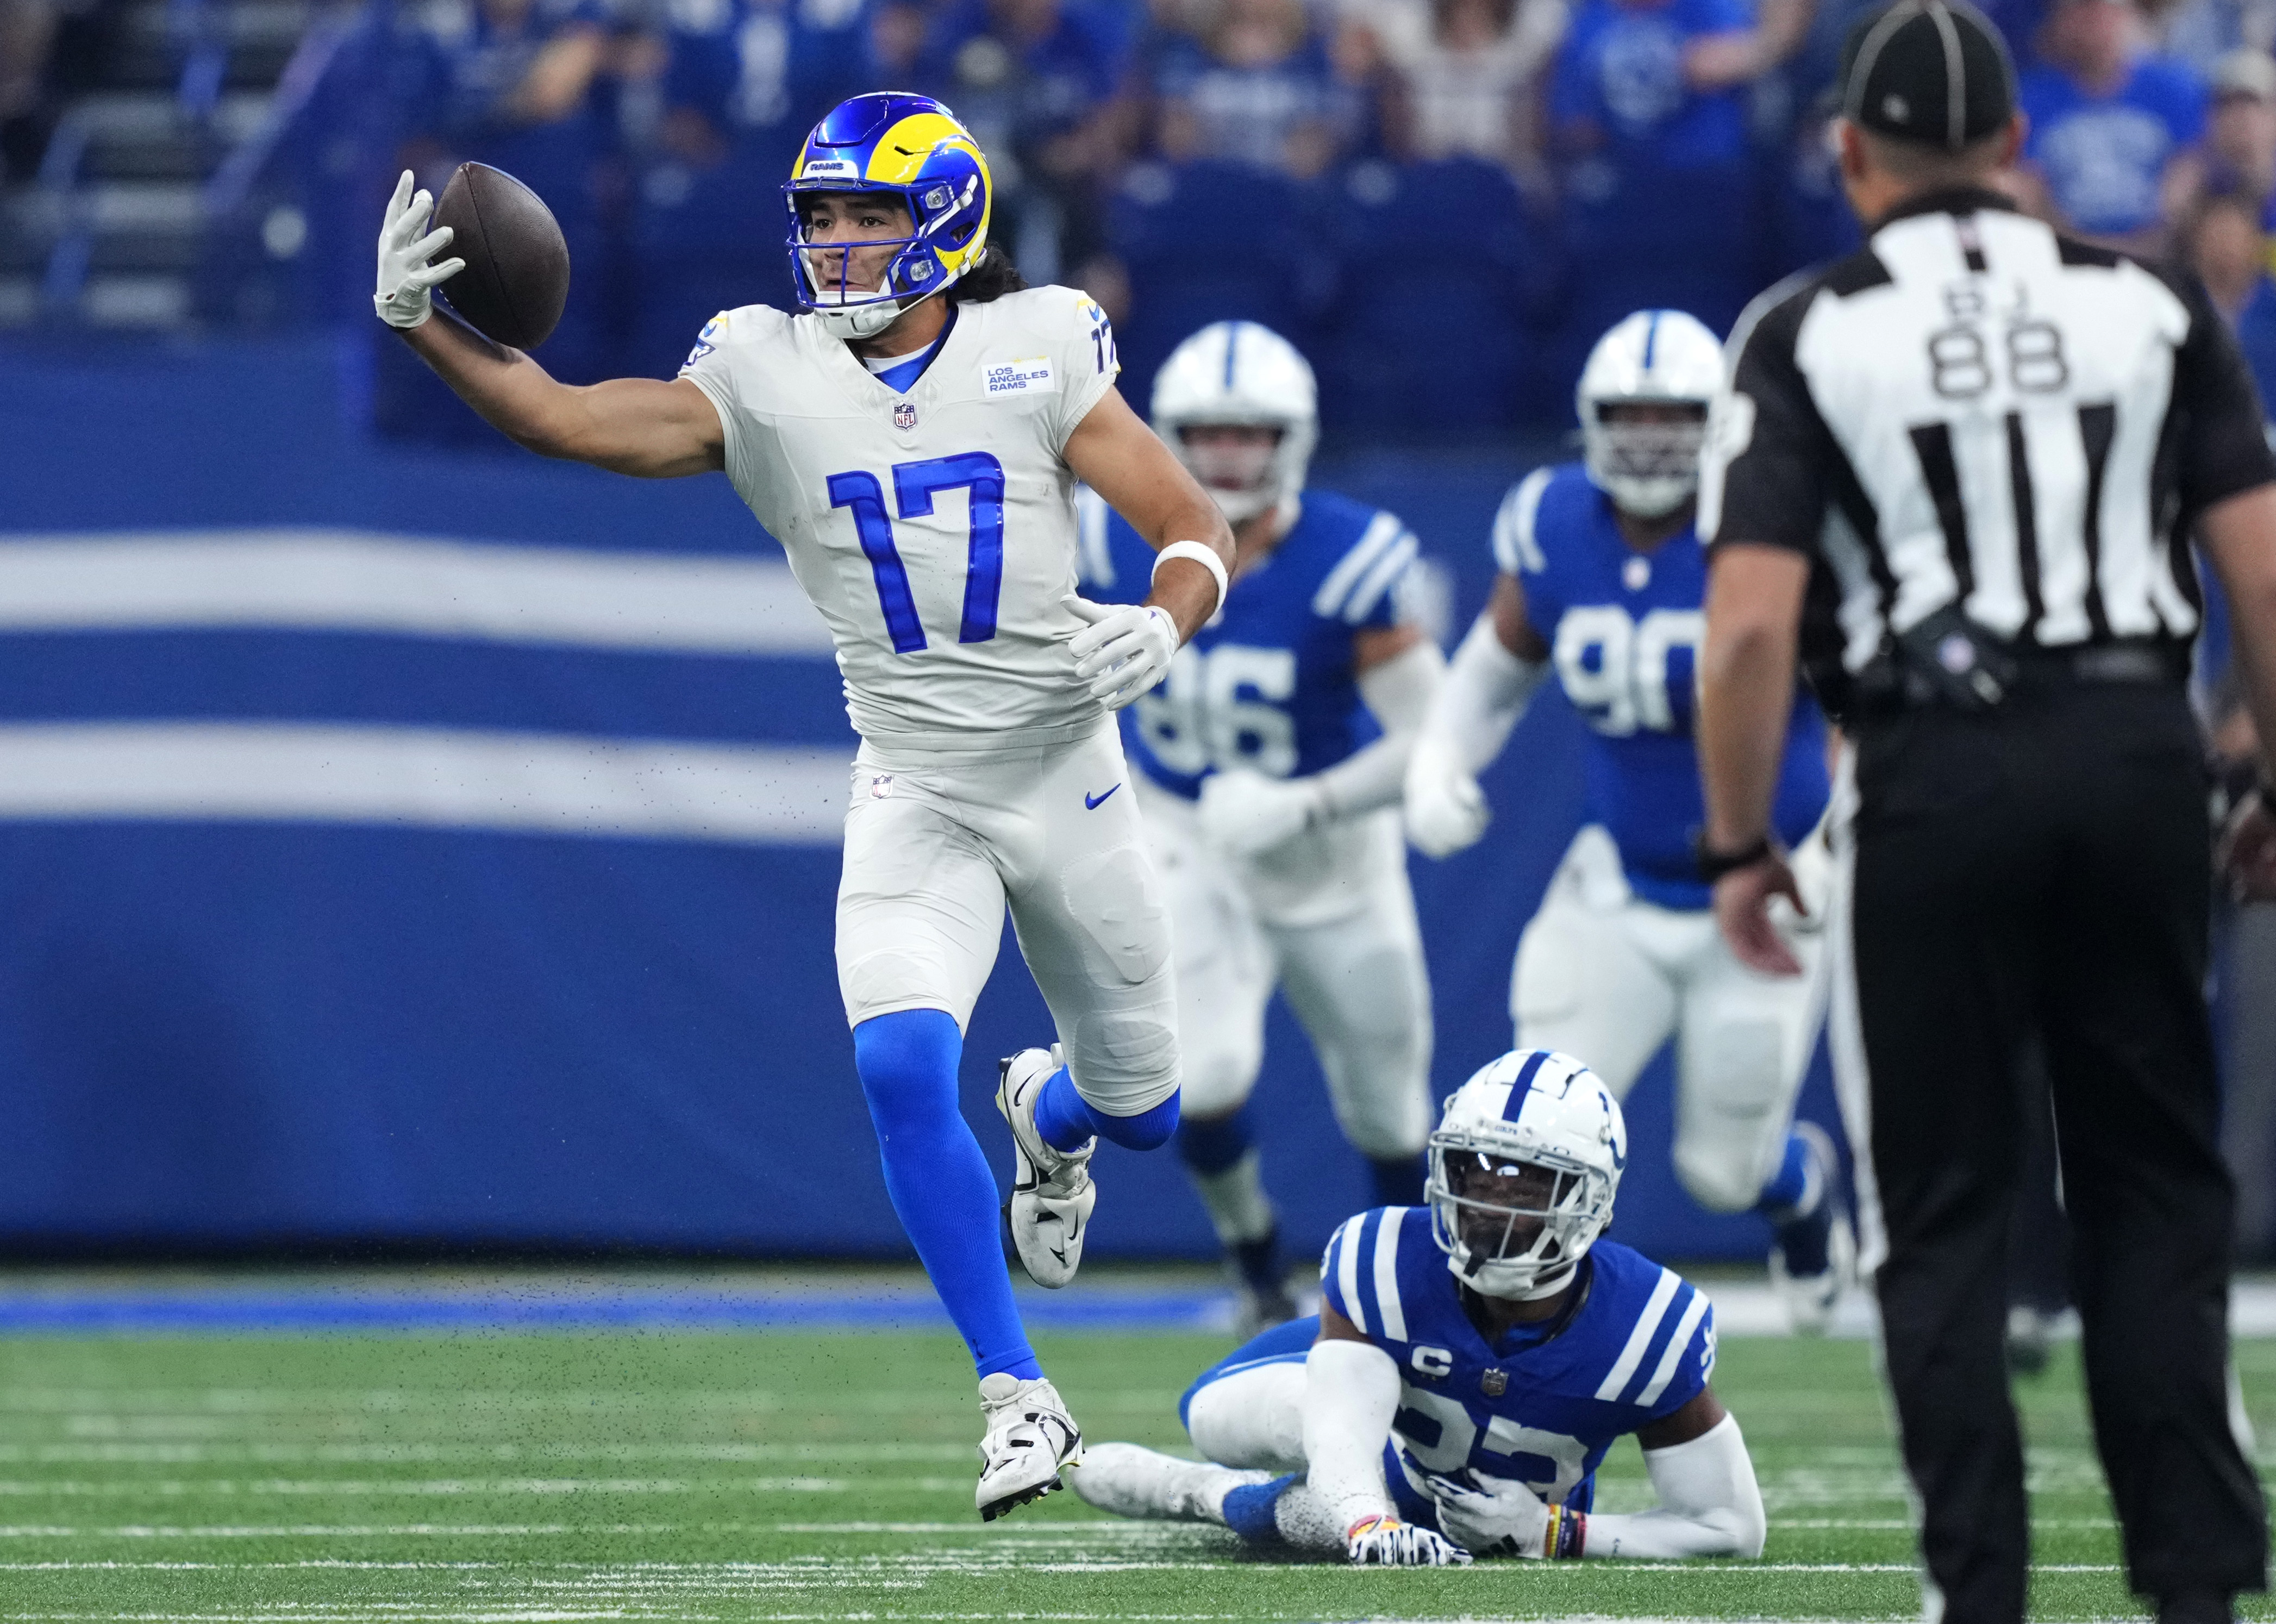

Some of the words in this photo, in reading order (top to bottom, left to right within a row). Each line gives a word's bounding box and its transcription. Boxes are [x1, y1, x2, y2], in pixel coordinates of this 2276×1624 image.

[810, 162, 845, 171] RAMS
[1927, 322, 2069, 402] 88
[988, 367, 1013, 376] LOS
[989, 370, 1049, 384] ANGELES
[990, 381, 1027, 392] RAMS
[897, 414, 914, 426] NFL
[826, 451, 1005, 654] 17
[1411, 1345, 1453, 1377] C
